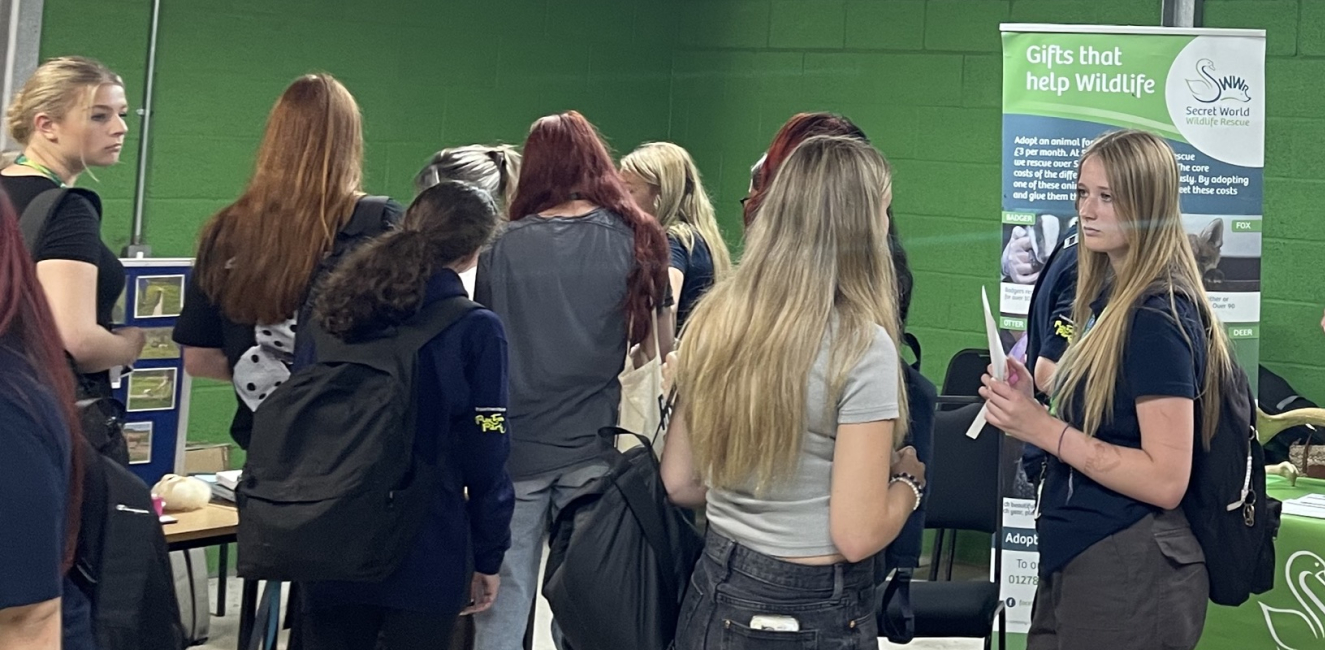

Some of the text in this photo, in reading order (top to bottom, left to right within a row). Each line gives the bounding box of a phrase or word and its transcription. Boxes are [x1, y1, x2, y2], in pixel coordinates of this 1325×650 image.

[1026, 44, 1123, 69] Gifts that
[1026, 71, 1156, 98] help Wildlife
[1186, 106, 1250, 117] Secret World
[1186, 117, 1250, 127] Wildlife Rescue
[1014, 136, 1038, 147] Adopt
[1051, 138, 1081, 146] animal
[1013, 147, 1024, 157] £3
[1025, 149, 1038, 157] per
[1039, 148, 1069, 157] month.
[1070, 149, 1080, 157] At
[1013, 159, 1026, 167] we
[1026, 160, 1052, 168] rescue
[1013, 169, 1033, 178] costs
[1034, 170, 1043, 180] of
[1044, 170, 1058, 179] the
[1028, 180, 1037, 190] of
[1037, 181, 1060, 189] these
[1198, 175, 1210, 186] By
[1211, 175, 1250, 187] adopting
[1192, 186, 1215, 194] these
[1216, 187, 1238, 195] costs
[1013, 191, 1028, 199] and
[1029, 192, 1046, 202] give
[1047, 192, 1069, 200] them
[1006, 213, 1033, 223] BADGER
[1235, 221, 1251, 230] FOX
[1003, 319, 1024, 328] OTTER
[1233, 328, 1253, 336] DEER
[1005, 532, 1038, 547] Adopt
[1016, 558, 1027, 569] To
[1008, 574, 1039, 586] 01278
